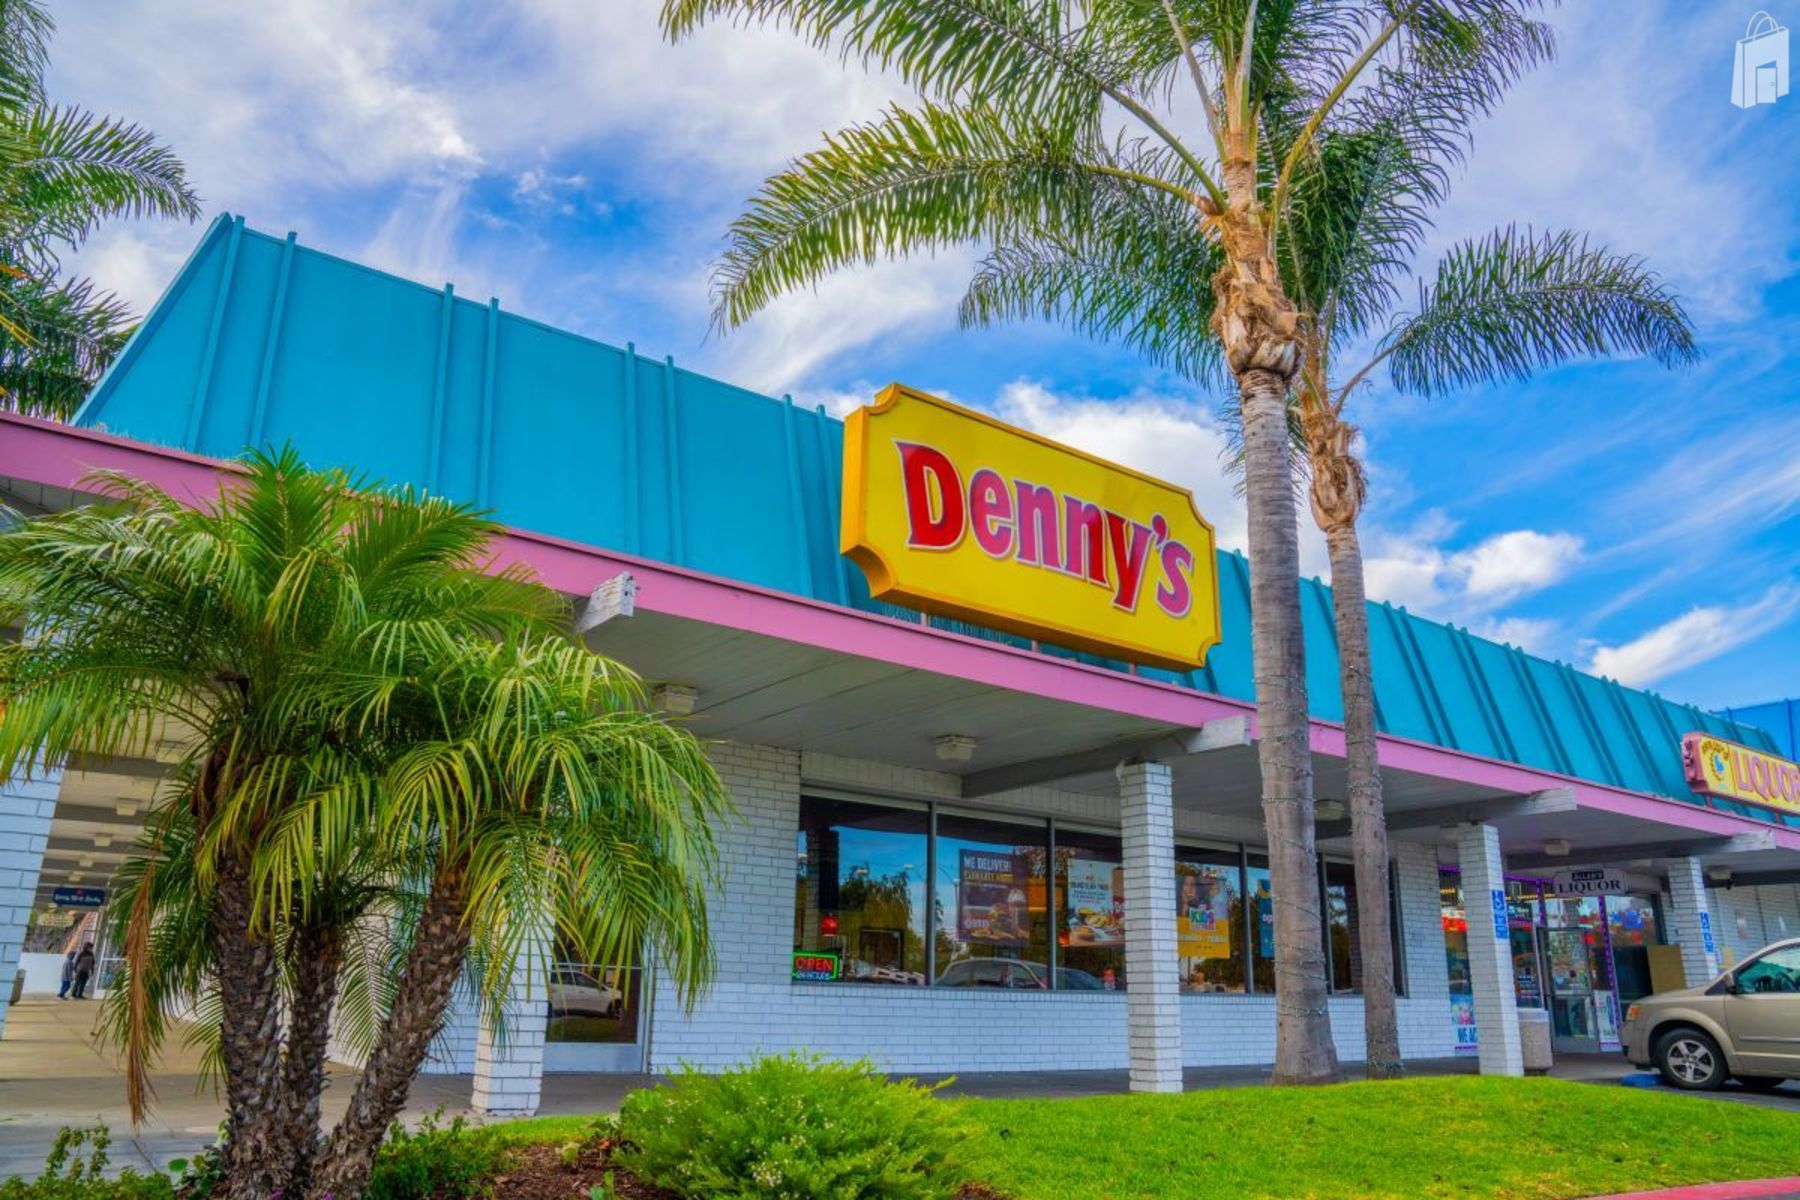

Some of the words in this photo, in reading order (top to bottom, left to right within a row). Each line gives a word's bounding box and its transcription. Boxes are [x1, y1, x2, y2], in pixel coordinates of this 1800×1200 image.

[894, 438, 1195, 619] Denny's
[1558, 879, 1622, 894] LIQUOR
[796, 956, 832, 971] OPEN
